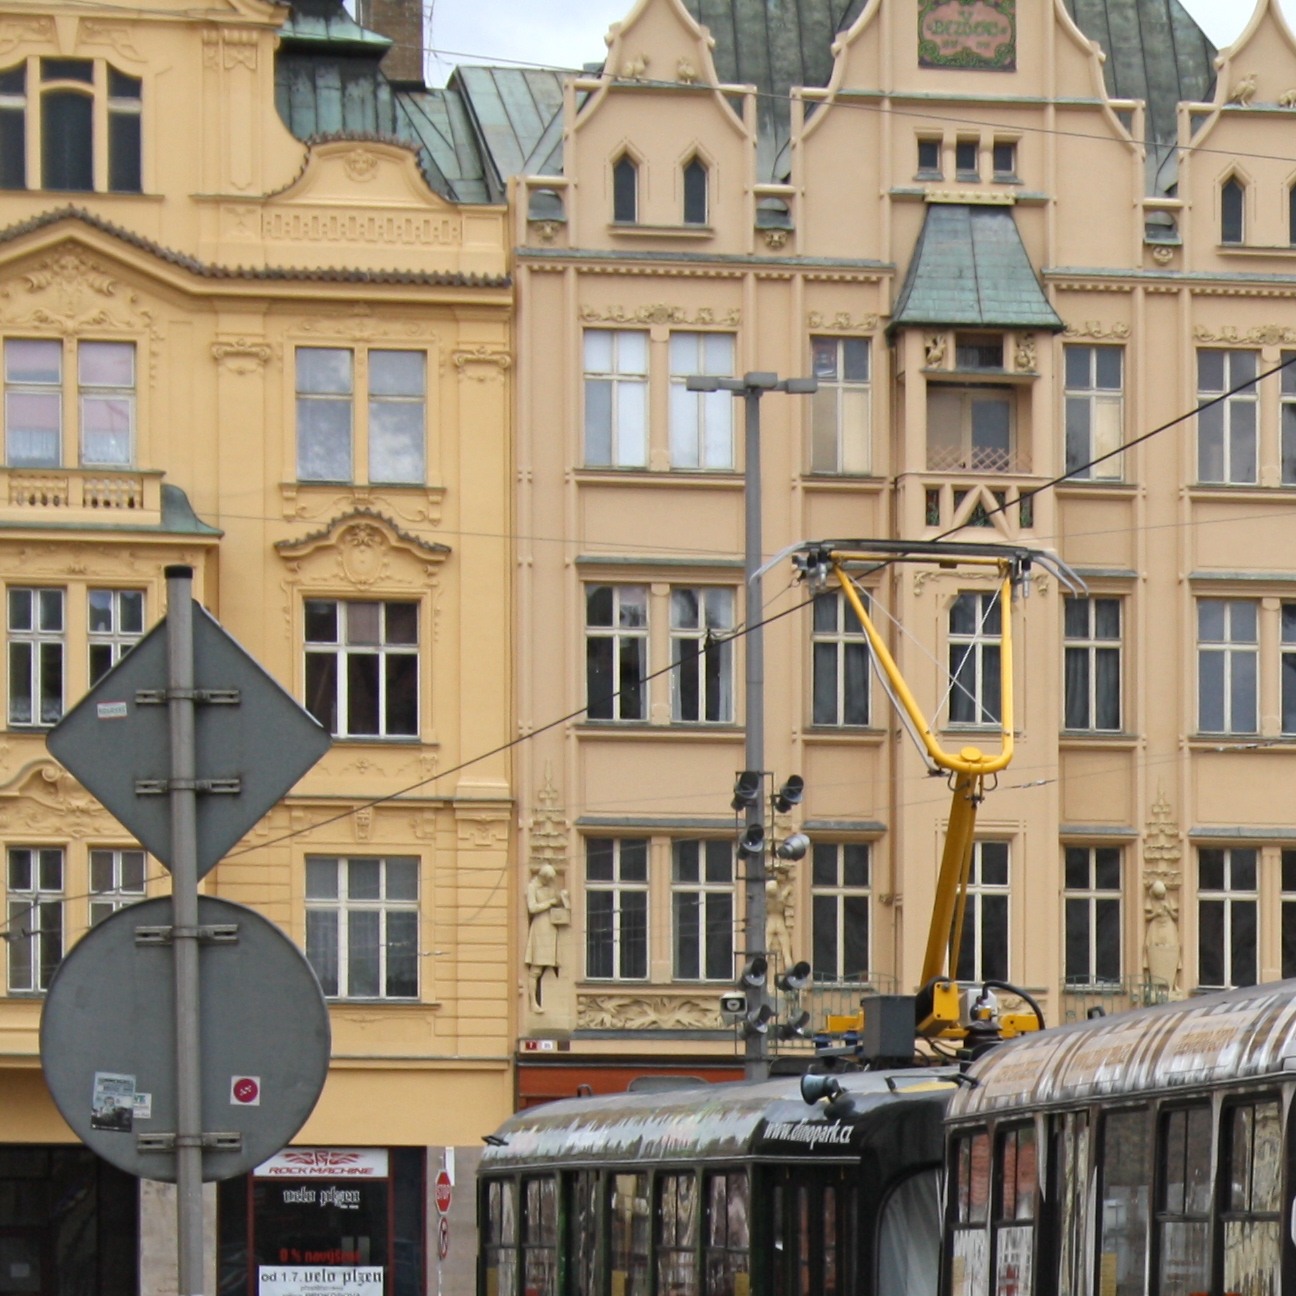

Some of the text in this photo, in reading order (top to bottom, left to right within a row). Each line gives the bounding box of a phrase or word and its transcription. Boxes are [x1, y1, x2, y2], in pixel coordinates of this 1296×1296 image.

[763, 1117, 855, 1150] www.dinopark.cz
[268, 1166, 374, 1176] ROCK MACHINE
[261, 1270, 277, 1283] od
